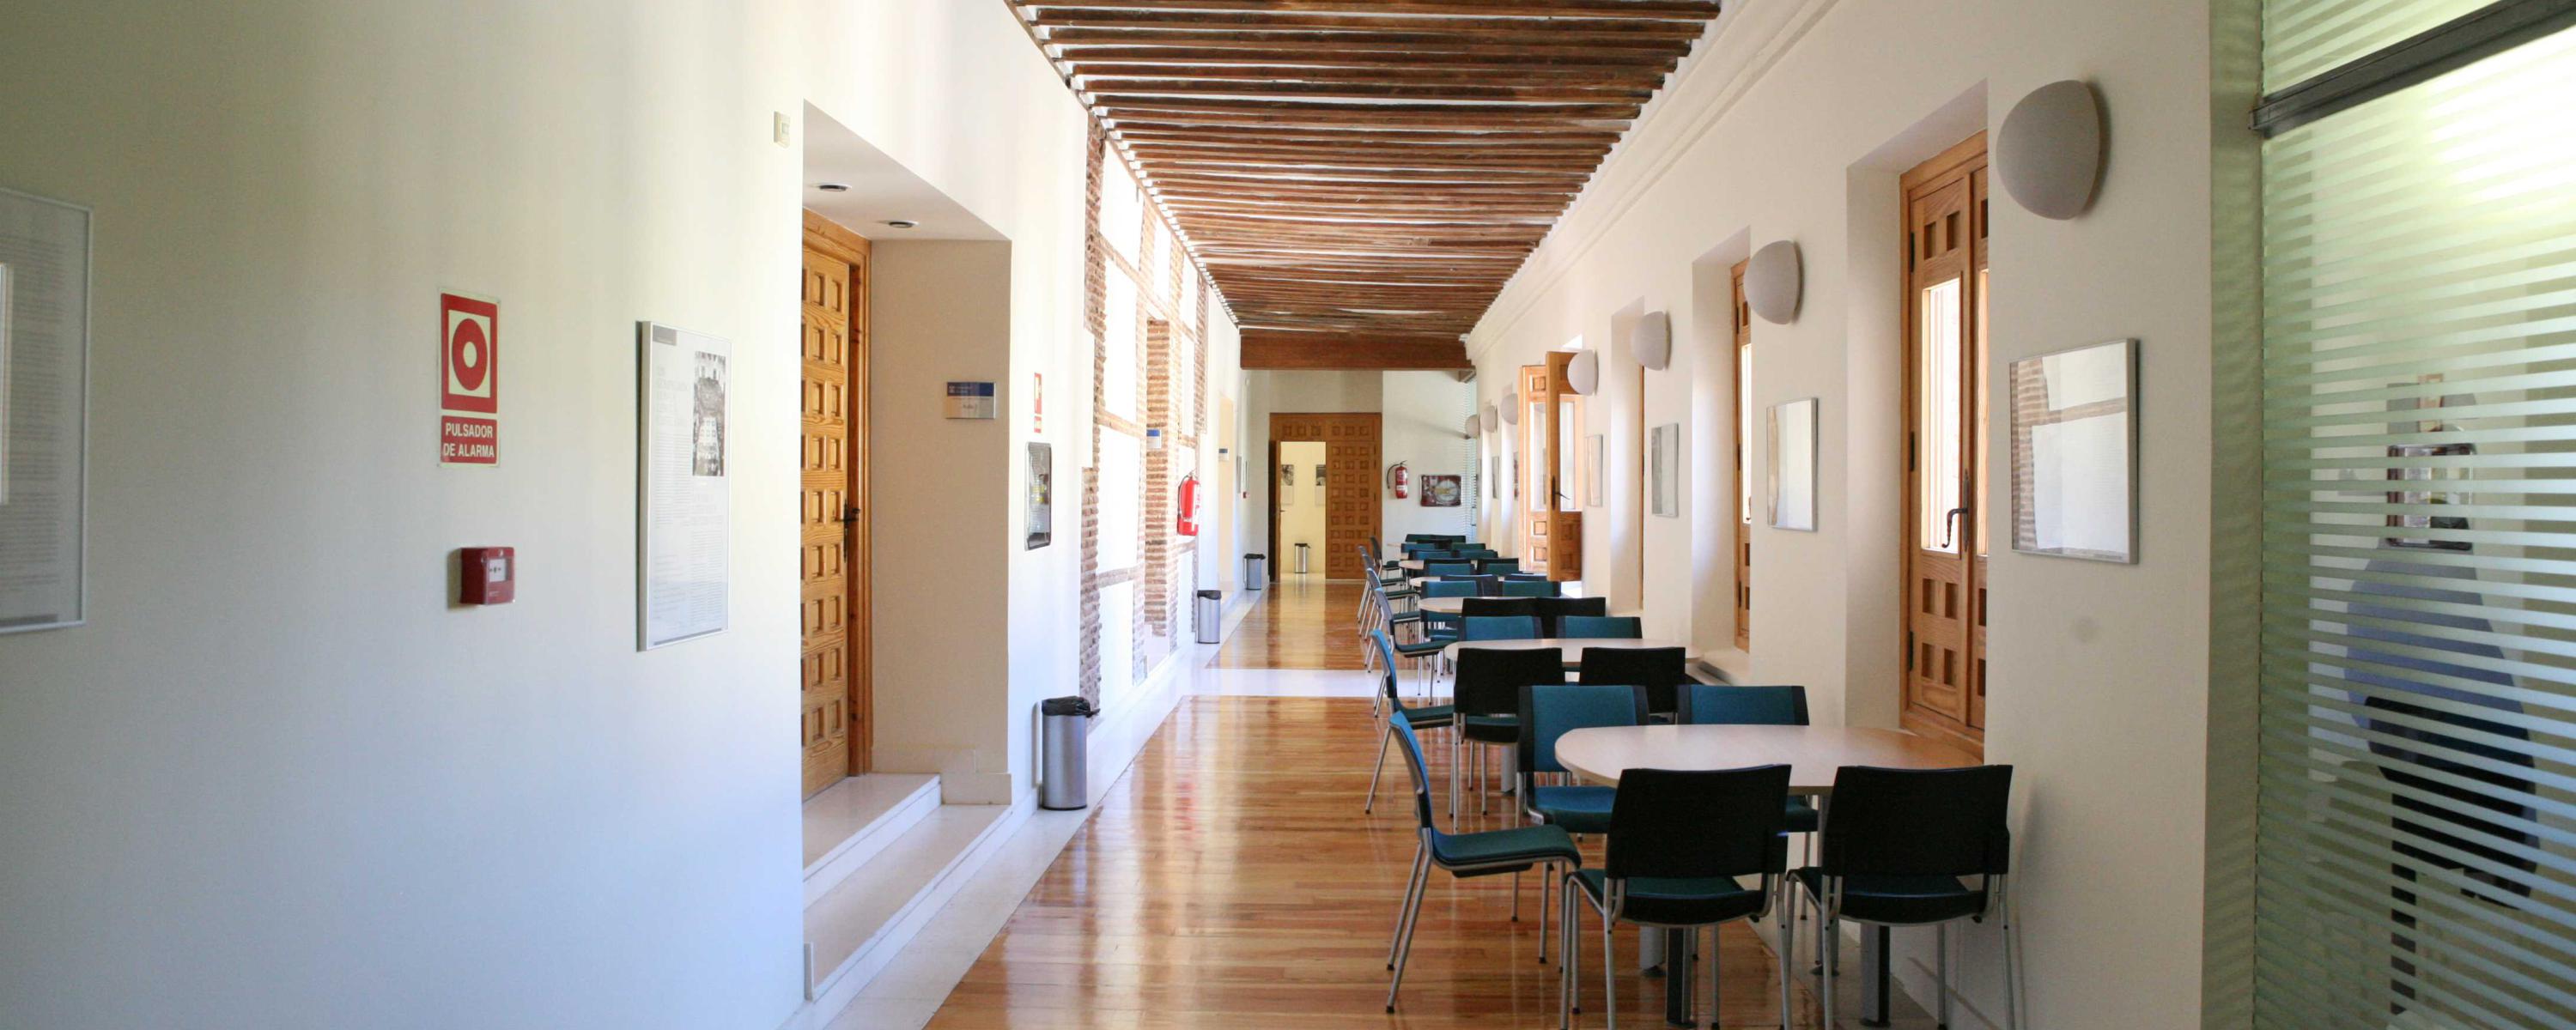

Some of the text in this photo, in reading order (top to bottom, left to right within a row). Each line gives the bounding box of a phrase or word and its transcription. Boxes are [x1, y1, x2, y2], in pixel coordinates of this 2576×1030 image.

[446, 422, 493, 438] PULSADOR
[443, 443, 495, 457] DE ALARMA
